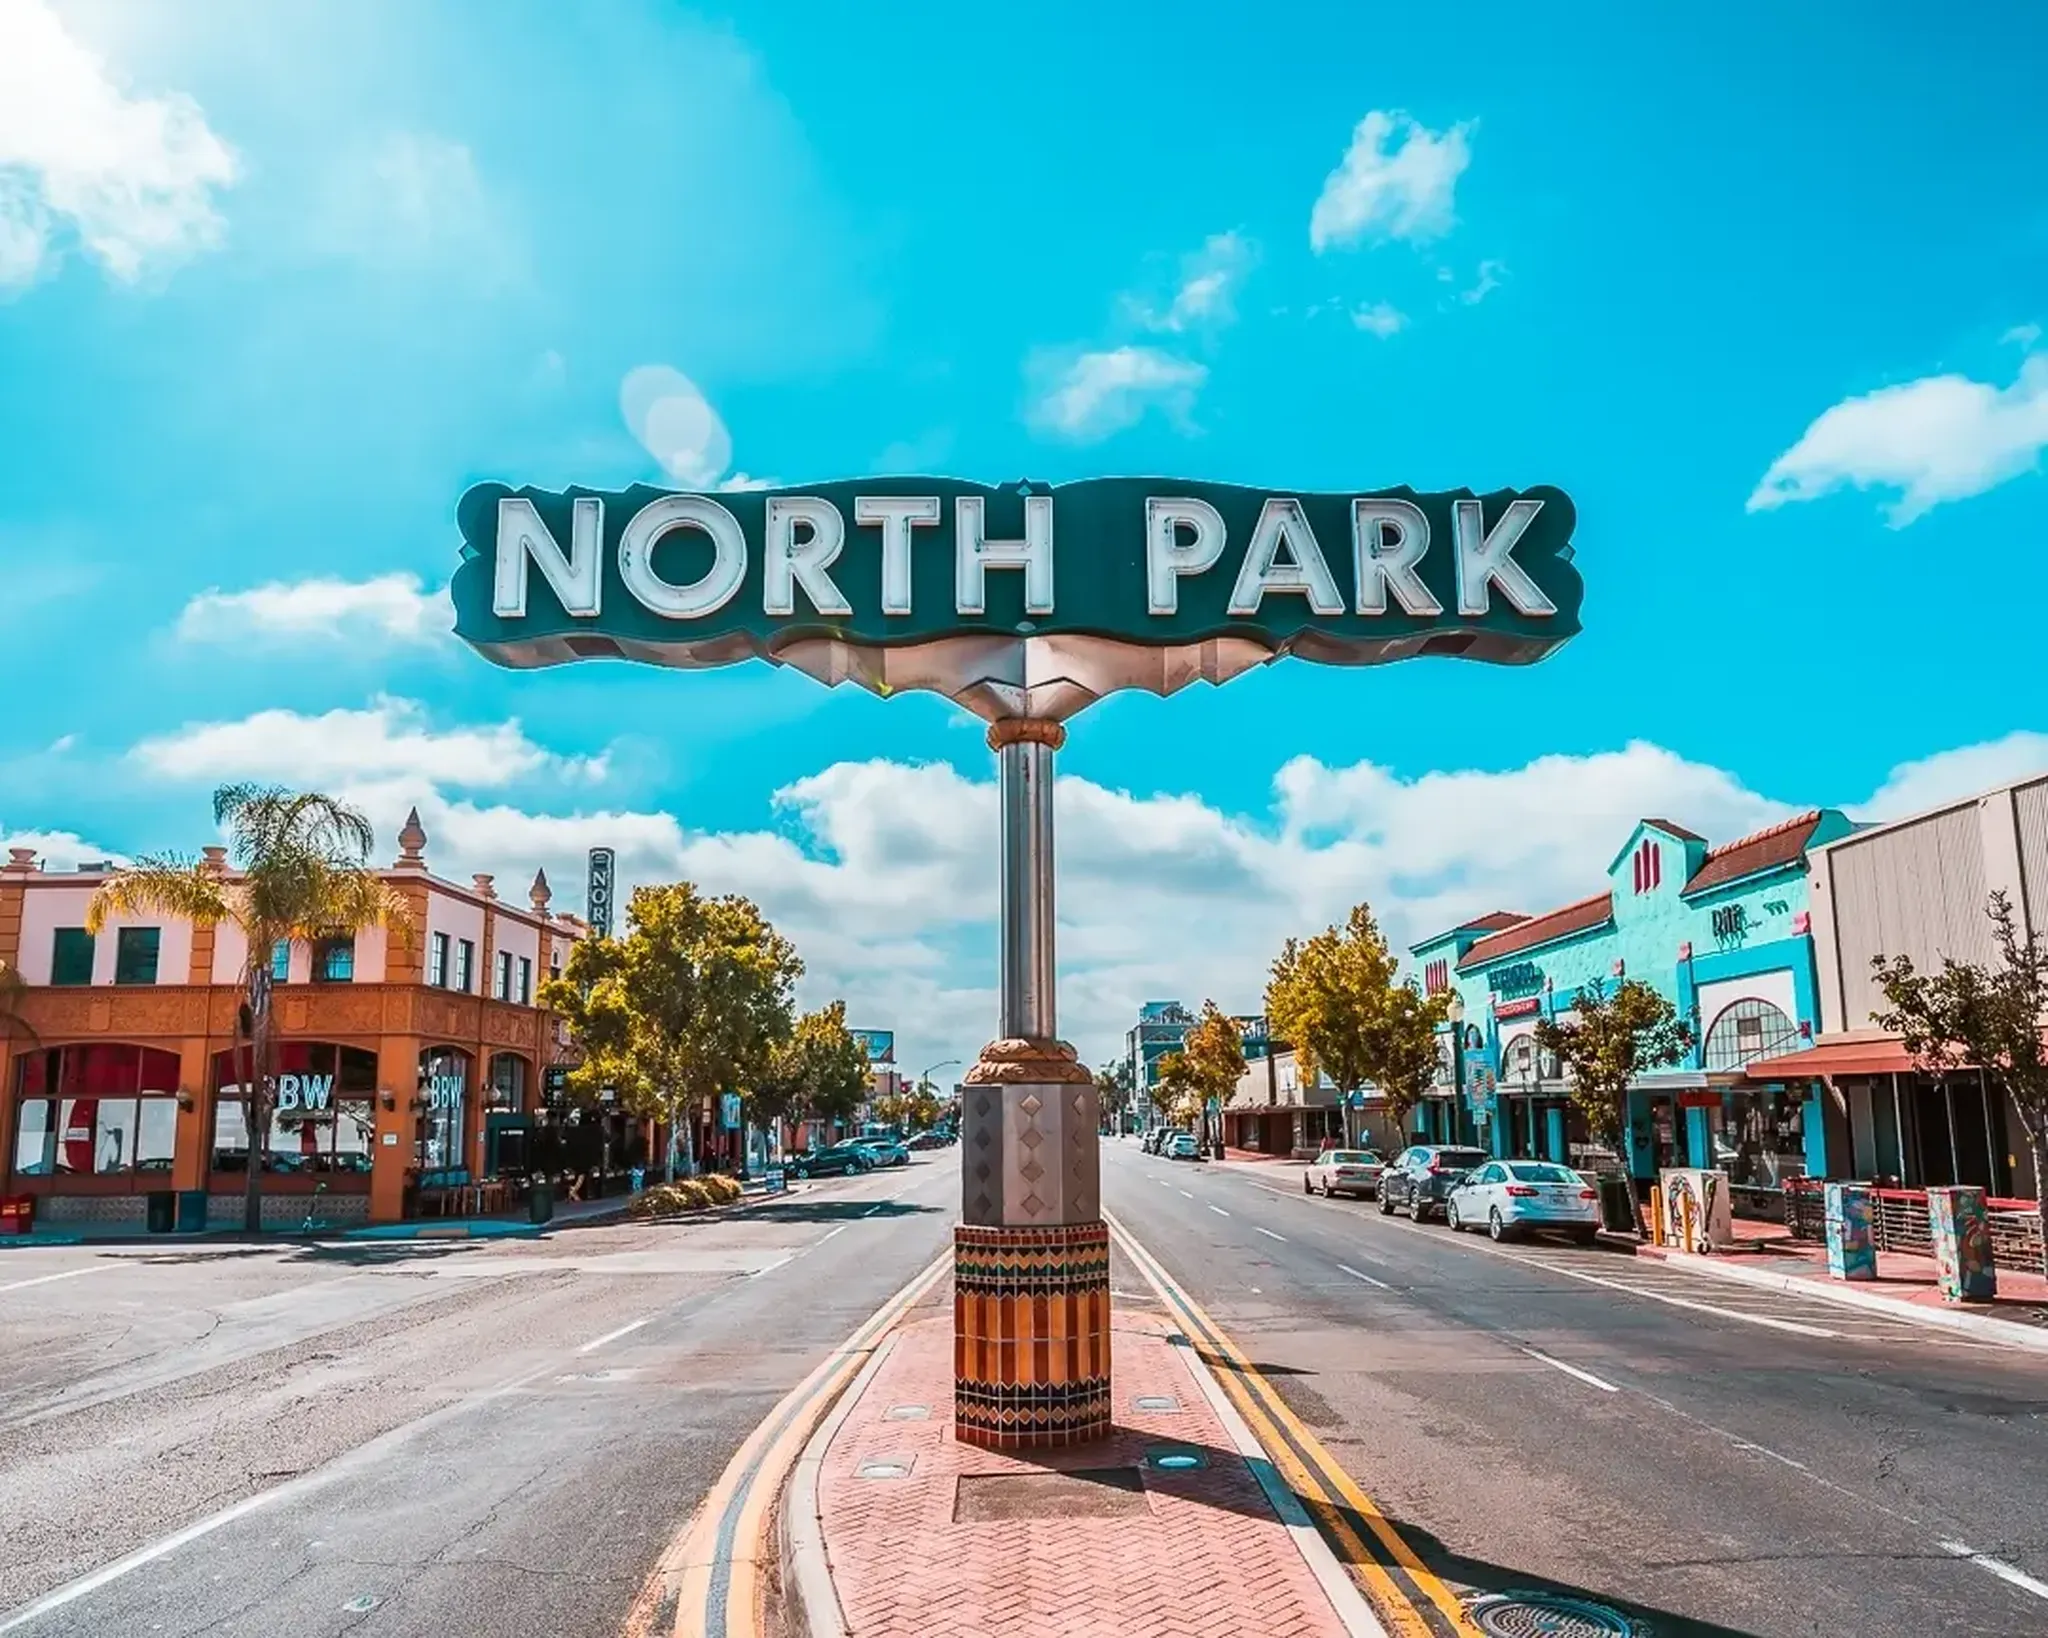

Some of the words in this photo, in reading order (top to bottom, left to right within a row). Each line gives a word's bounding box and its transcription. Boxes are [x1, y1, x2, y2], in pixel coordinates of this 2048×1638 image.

[493, 495, 1054, 619] NORTH
[1145, 497, 1558, 616] PARK
[431, 1076, 462, 1108] BBW
